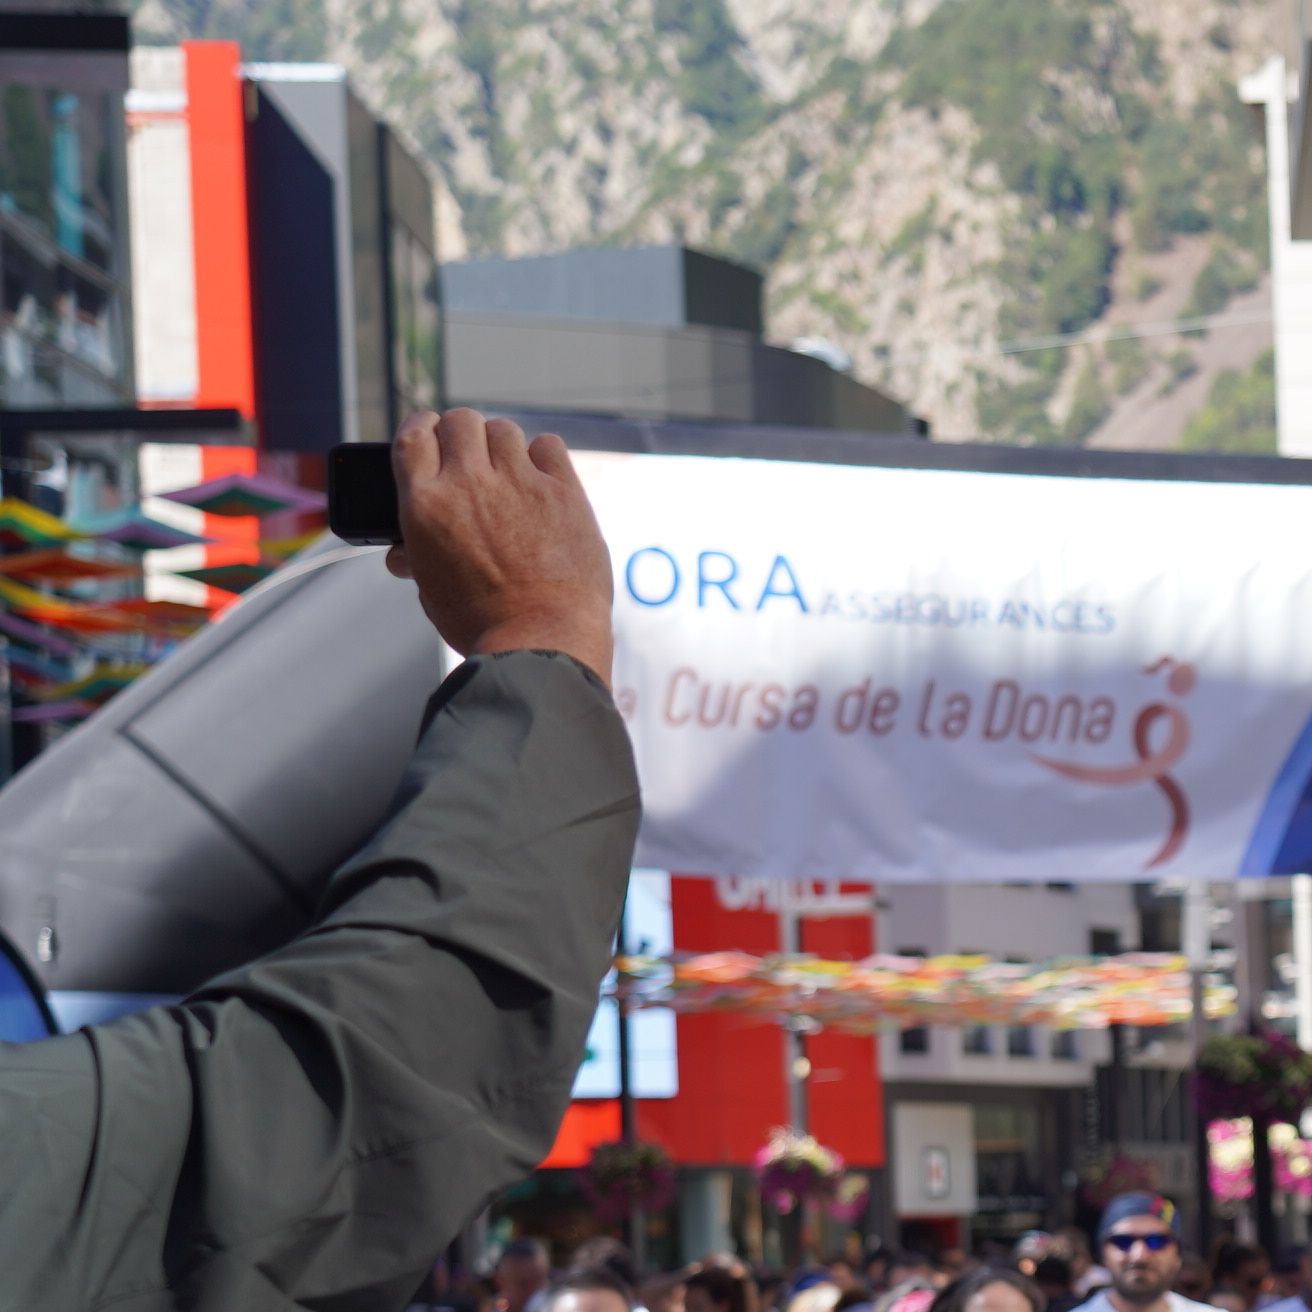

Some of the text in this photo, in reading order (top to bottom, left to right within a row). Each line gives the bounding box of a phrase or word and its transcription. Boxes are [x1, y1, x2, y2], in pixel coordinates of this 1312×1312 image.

[624, 546, 812, 614] ORA
[663, 666, 816, 734] Cursa
[833, 674, 897, 737] de
[916, 679, 966, 738] la
[981, 678, 1117, 746] Dona
